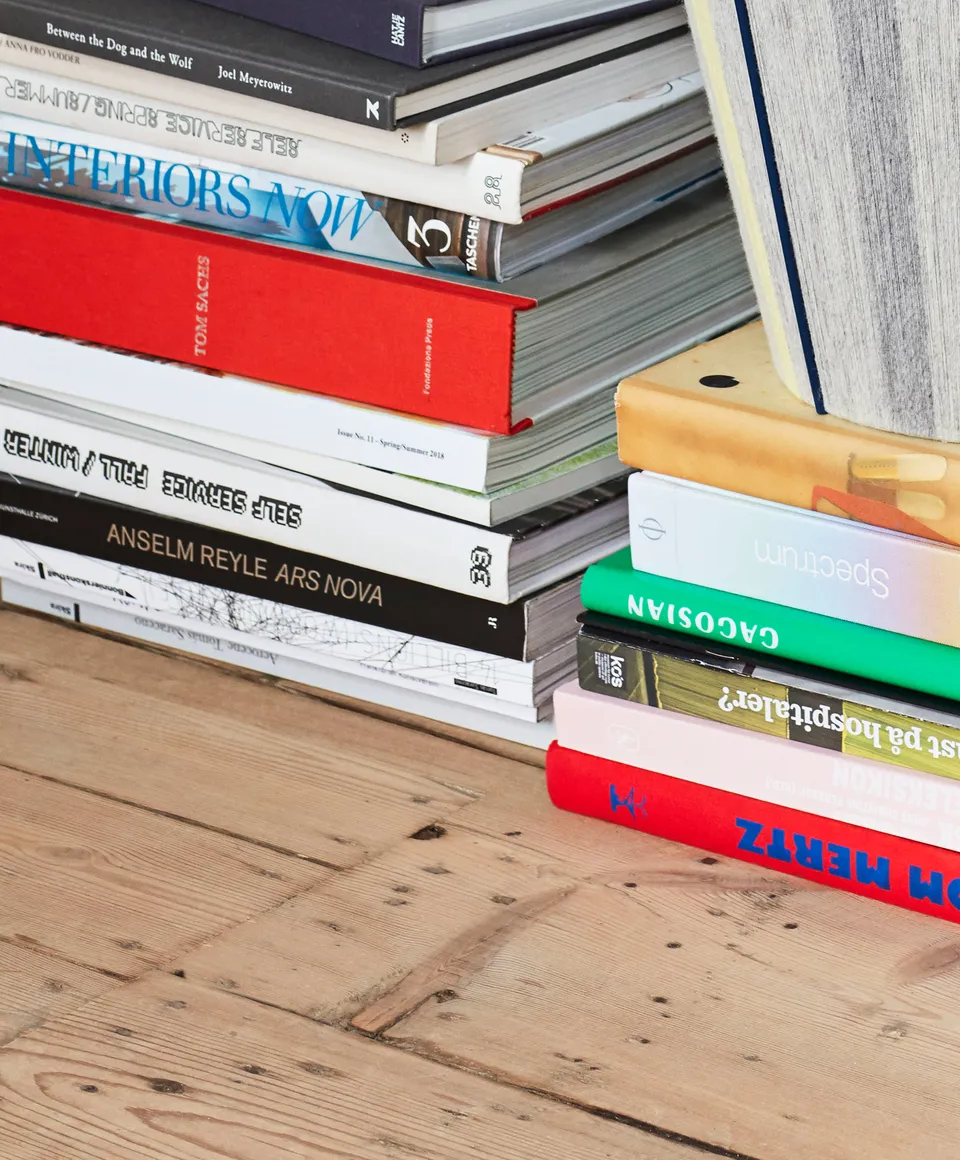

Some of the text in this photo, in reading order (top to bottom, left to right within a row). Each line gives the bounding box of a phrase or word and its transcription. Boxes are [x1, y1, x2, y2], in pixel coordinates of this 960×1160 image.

[46, 22, 193, 70] Between the Dog and the Wolf
[48, 50, 81, 65] VODDER
[218, 65, 293, 94] Joel Meyerowitz
[166, 111, 248, 147] SERVICE
[250, 128, 302, 158] SELF
[4, 132, 385, 241] INTERIORS NOW
[408, 216, 452, 253] 3
[194, 255, 210, 356] TOM SACHS
[423, 318, 434, 395] Fondazione Prada
[3, 428, 80, 472] WINTER
[337, 428, 354, 438] Issue
[355, 432, 366, 441] No.
[367, 435, 375, 443] 11
[380, 439, 429, 456] Spring/Summer
[429, 449, 445, 460] 2018
[99, 453, 149, 490] FALL
[162, 470, 248, 515] SERVICE
[252, 495, 303, 529] SELF
[106, 523, 384, 607] ANSELM REYLE ARS NOVA
[754, 542, 890, 599] Spectrum
[718, 686, 881, 748] hospitaler?
[887, 726, 922, 755] på
[735, 817, 890, 891] MERTZ
